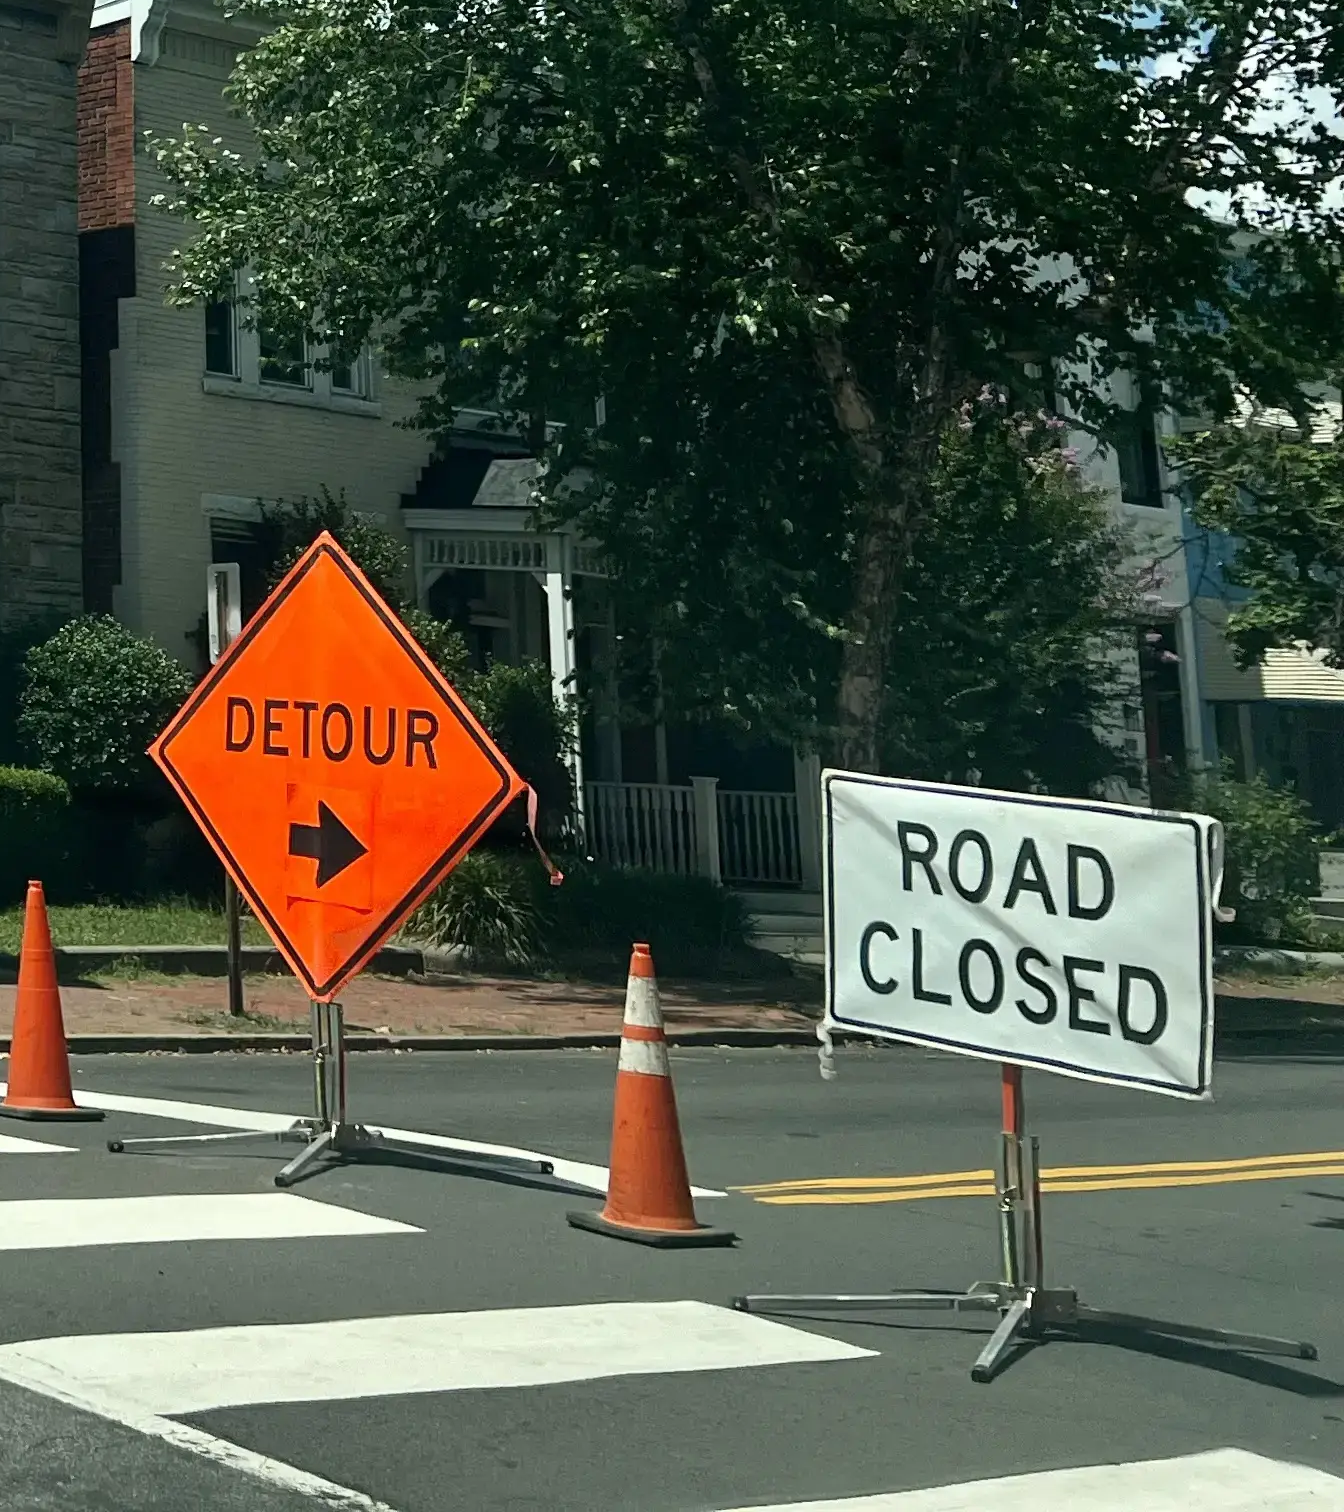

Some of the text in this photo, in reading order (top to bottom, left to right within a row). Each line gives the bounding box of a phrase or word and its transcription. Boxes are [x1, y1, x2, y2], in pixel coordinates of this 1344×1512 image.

[225, 696, 440, 770] DETOUR
[897, 820, 1116, 921] ROAD
[859, 921, 1168, 1046] CLOSED
